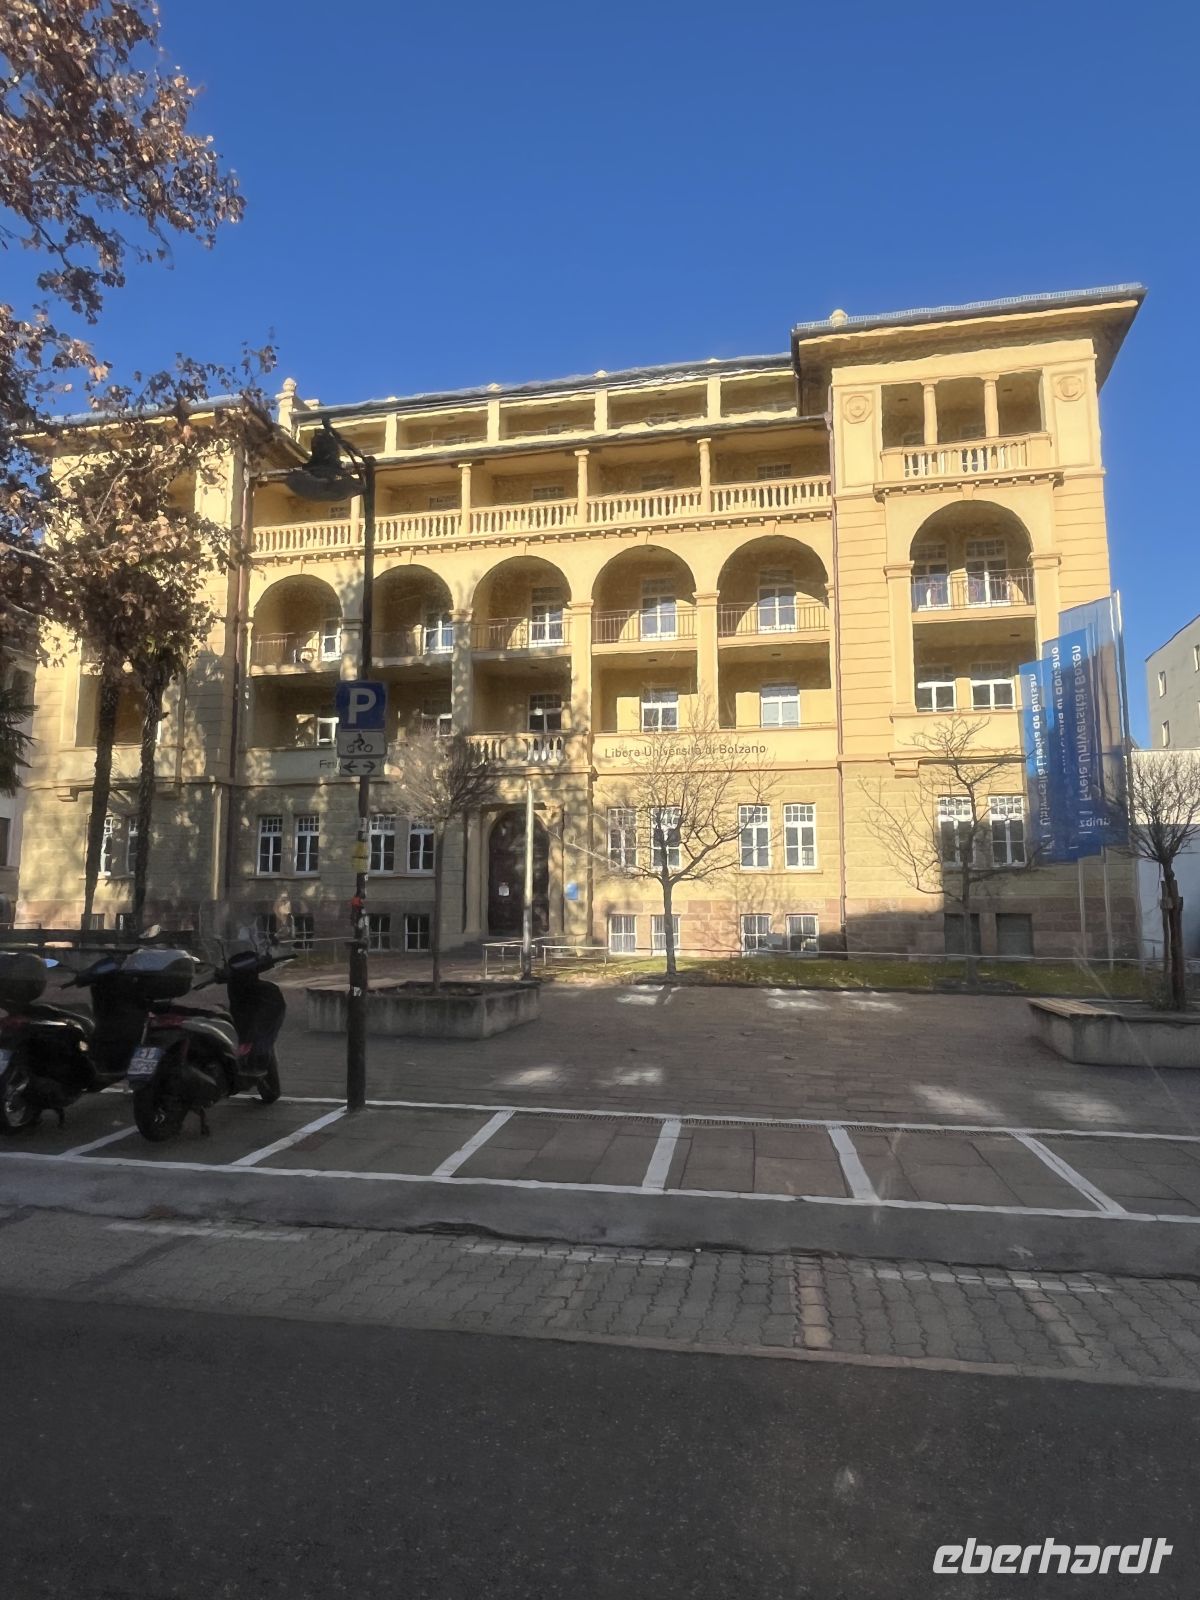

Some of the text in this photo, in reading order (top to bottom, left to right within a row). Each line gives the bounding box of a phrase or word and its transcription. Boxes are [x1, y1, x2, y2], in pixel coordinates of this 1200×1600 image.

[348, 688, 377, 724] P
[605, 748, 640, 758] Libera
[719, 743, 766, 754] Bolzano
